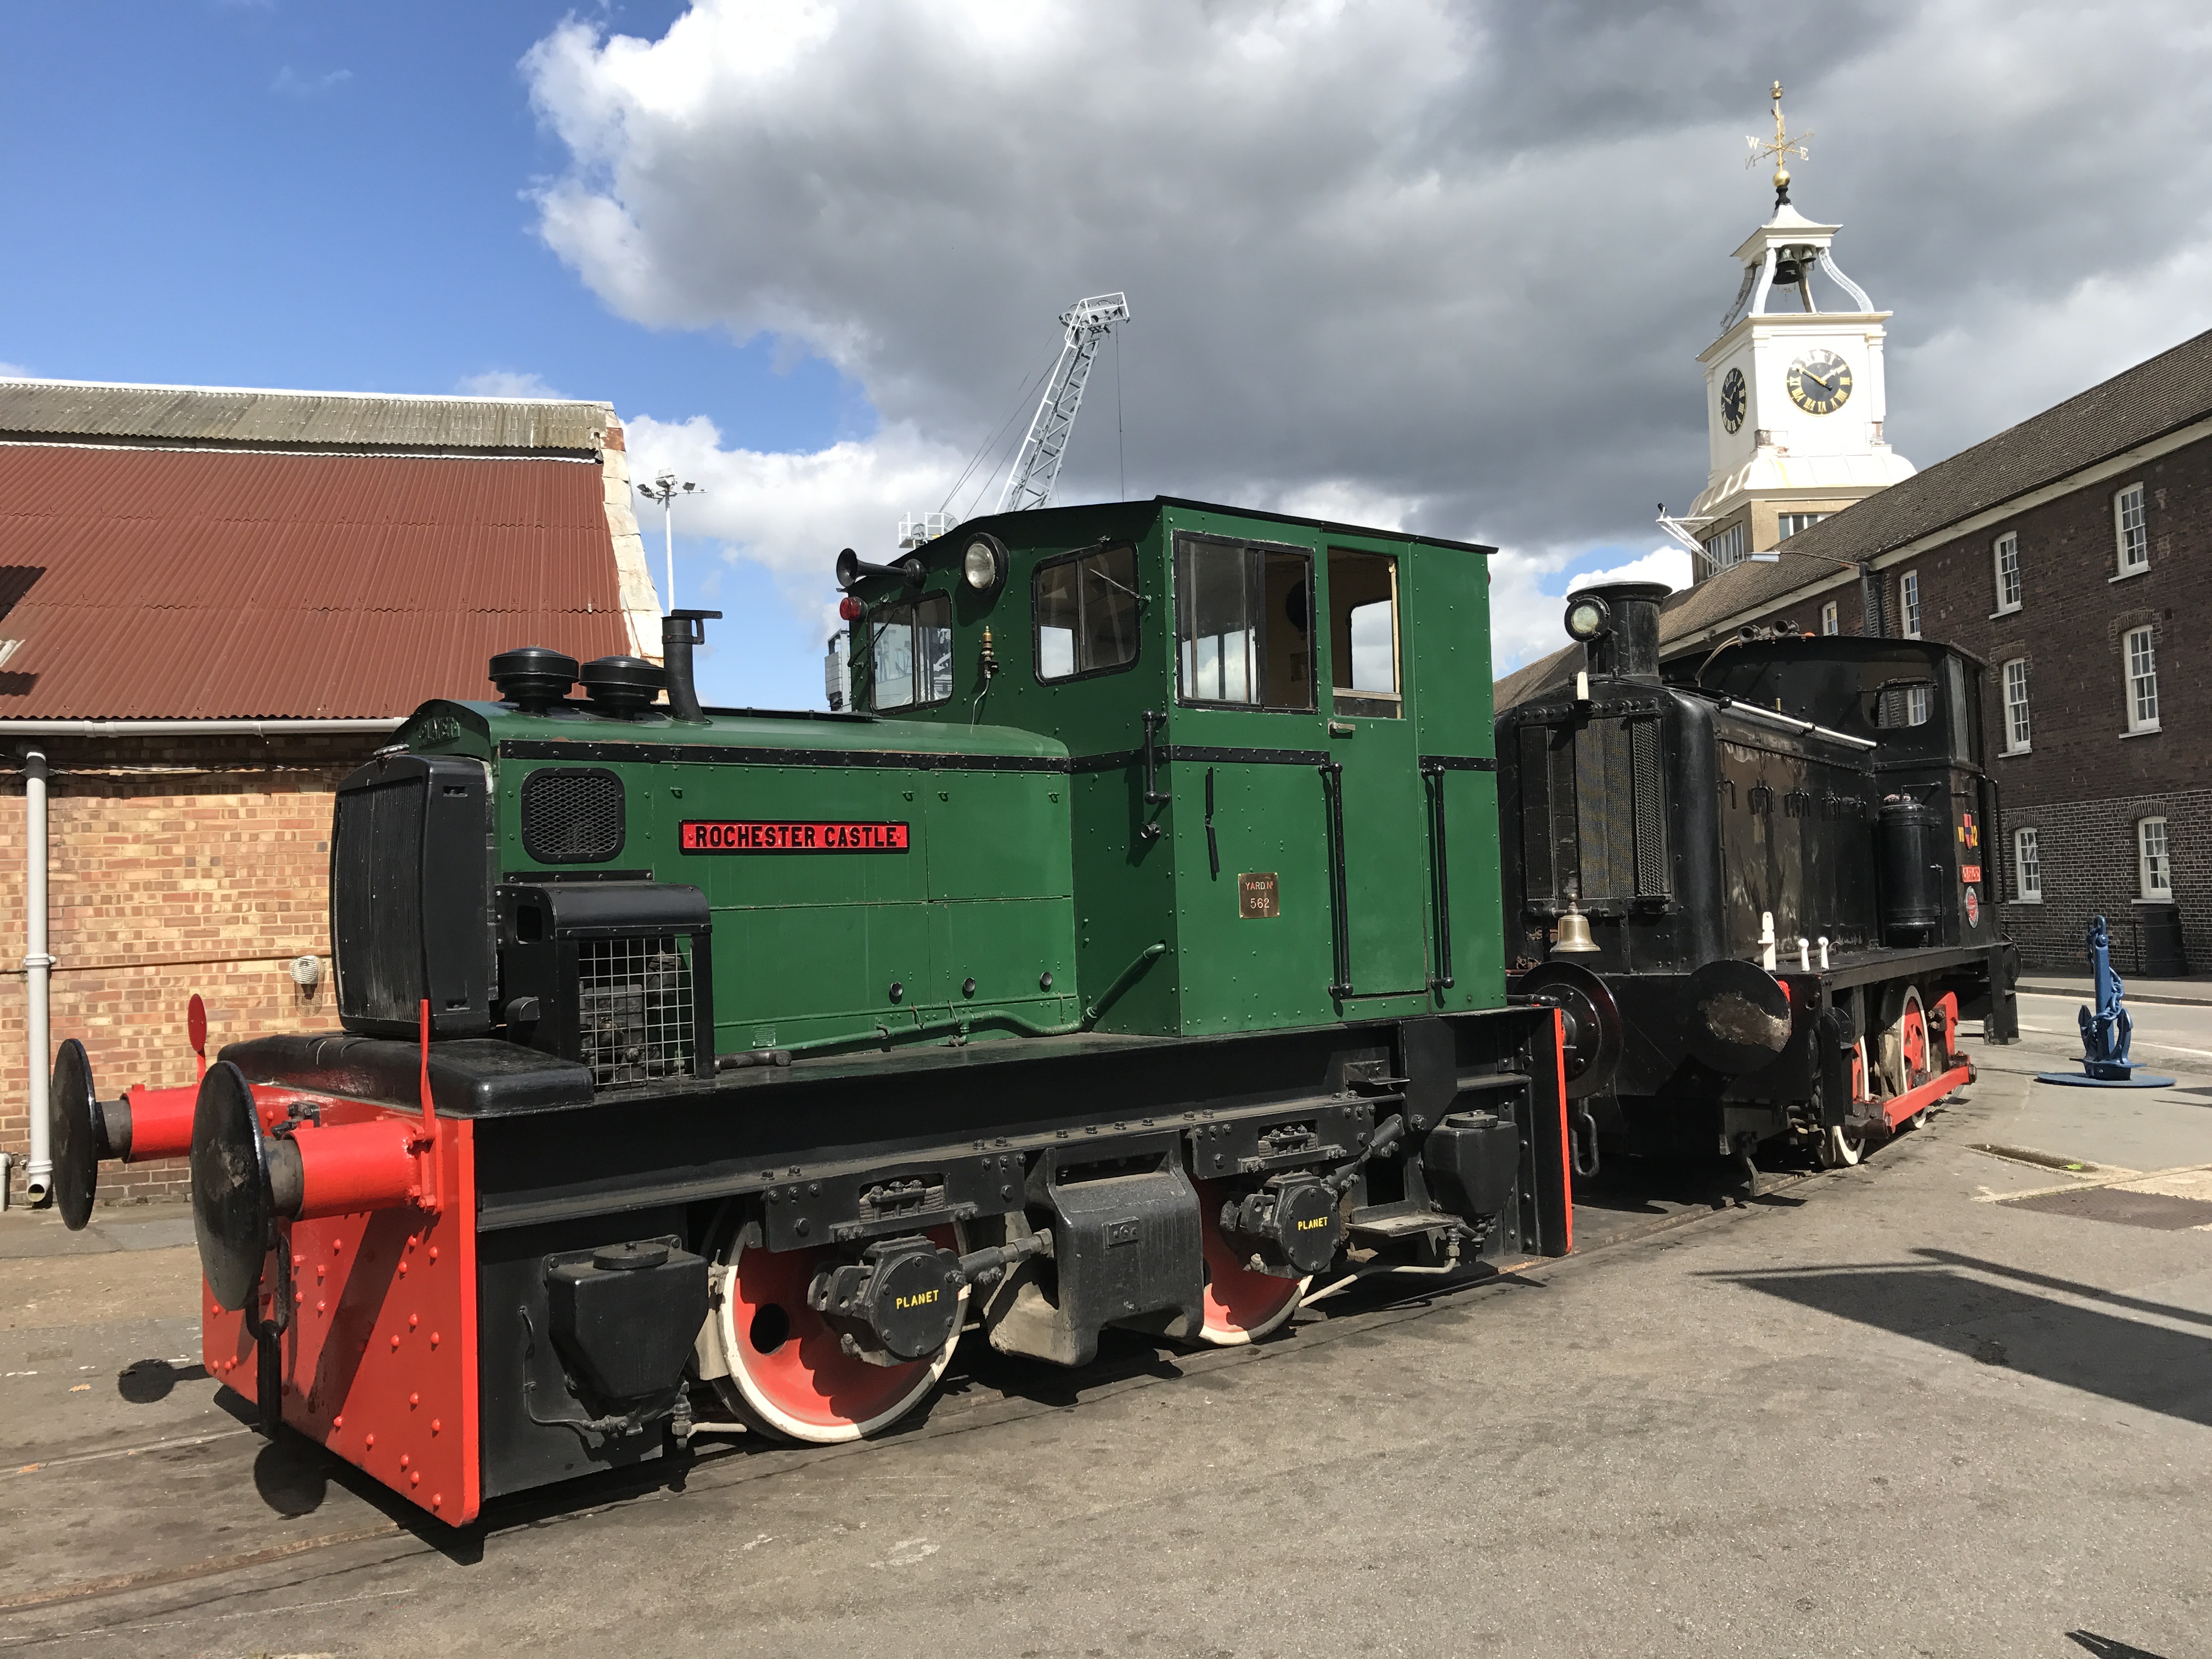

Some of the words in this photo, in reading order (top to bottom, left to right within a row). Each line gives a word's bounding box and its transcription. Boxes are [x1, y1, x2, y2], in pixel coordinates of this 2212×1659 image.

[1746, 136, 1760, 150] W
[1799, 146, 1809, 161] E
[1790, 376, 1801, 386] IX
[1839, 376, 1850, 386] III
[1791, 385, 1806, 403] VIII
[1834, 388, 1848, 403] IIII
[1803, 397, 1816, 411] VII
[1818, 401, 1827, 412] VI
[1830, 398, 1838, 409] V
[695, 825, 816, 848] ROCHESTER
[824, 826, 897, 848] CASTLE
[1245, 881, 1266, 890] YARD
[1250, 898, 1270, 909] 562
[1297, 1216, 1328, 1231] PLANET
[895, 1289, 940, 1310] PLANET
